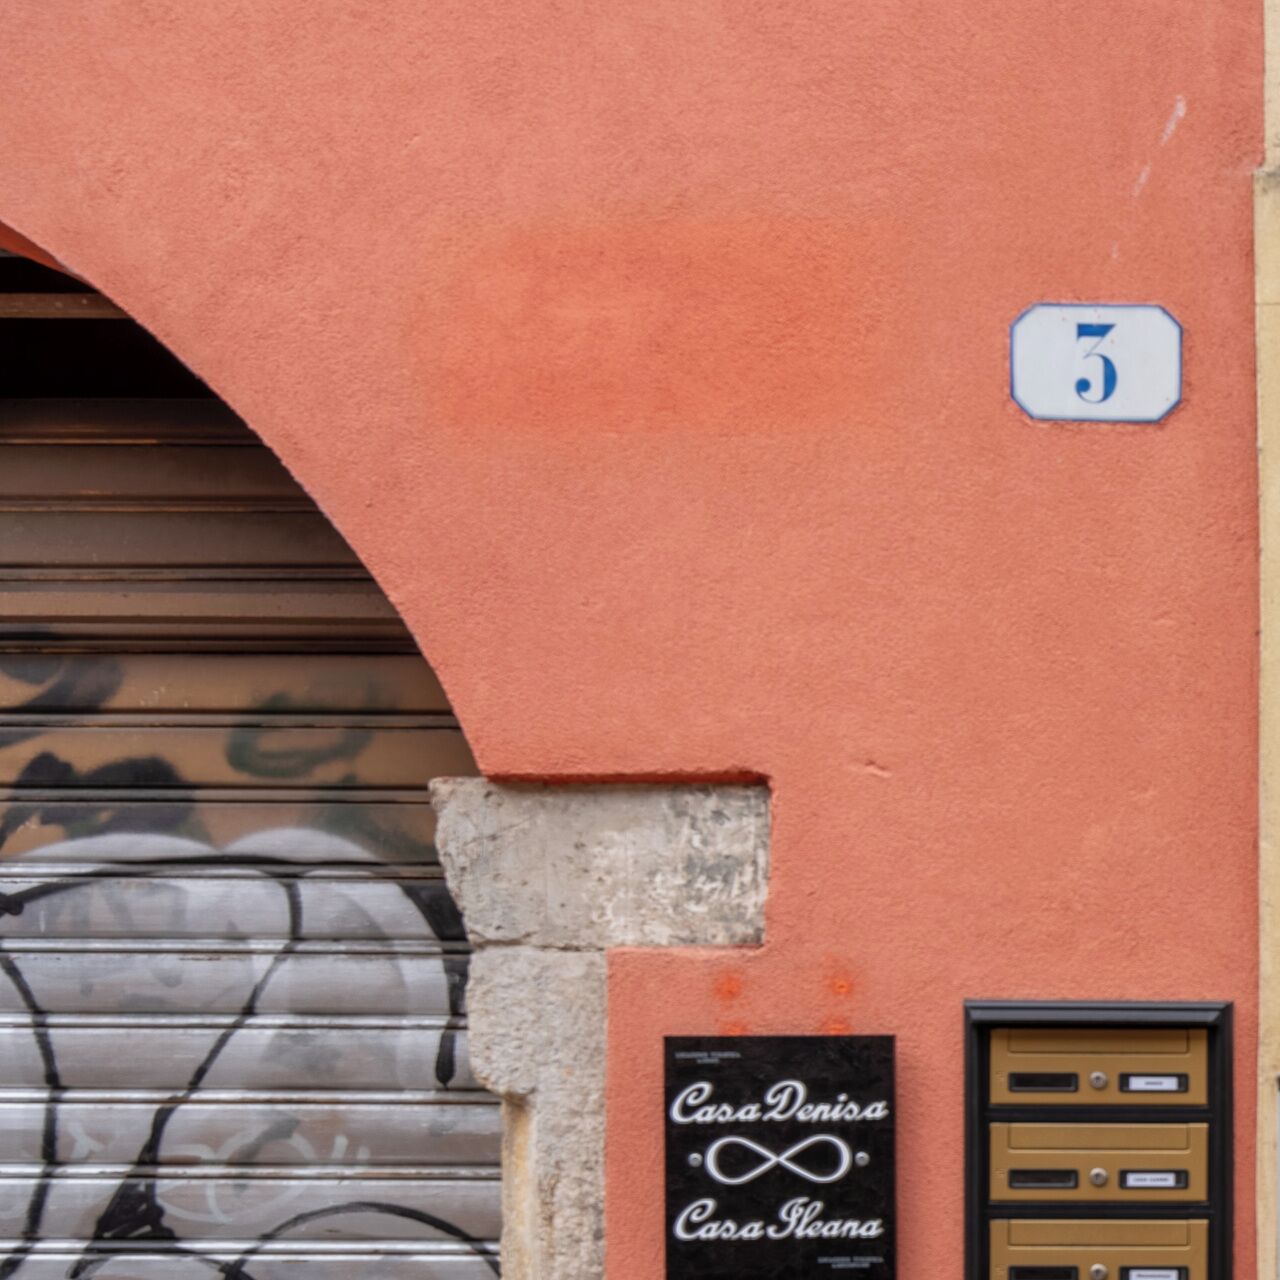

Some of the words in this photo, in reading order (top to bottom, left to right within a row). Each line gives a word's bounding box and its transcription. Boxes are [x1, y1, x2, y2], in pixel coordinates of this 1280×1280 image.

[1075, 323, 1117, 404] 3
[670, 1081, 762, 1124] Casa
[762, 1079, 889, 1122] Denisa
[673, 1198, 765, 1241] Casa
[765, 1197, 884, 1239] Ileana
